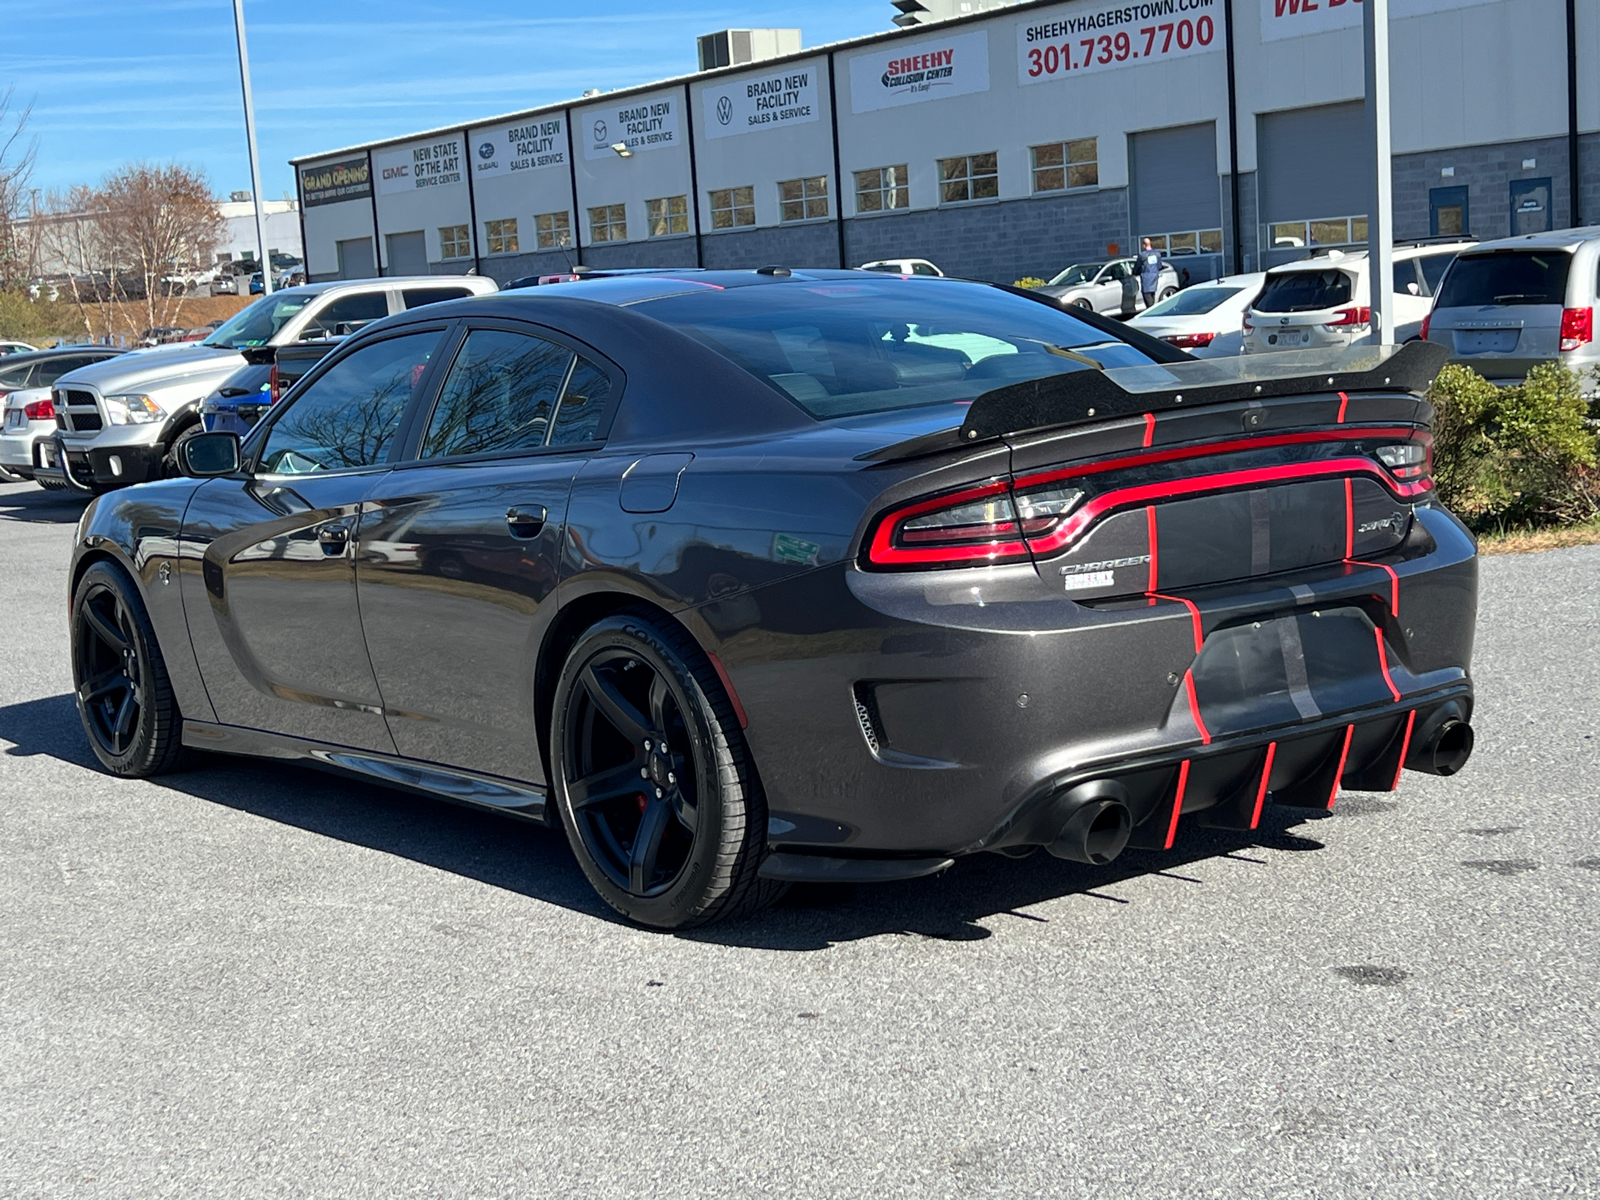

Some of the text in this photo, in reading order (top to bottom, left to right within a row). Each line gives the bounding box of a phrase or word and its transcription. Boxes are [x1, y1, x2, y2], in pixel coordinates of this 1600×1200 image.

[1028, 15, 1214, 77] 301.739.7700
[888, 48, 954, 76] SHEEHY
[747, 73, 808, 98] BRAND NEW
[889, 66, 953, 87] COLLISION CENTER
[756, 91, 799, 111] FACILITY
[619, 102, 670, 123] BRAND NEW
[748, 105, 811, 126] SALES & SERVICE
[508, 120, 560, 143] BRAND NEW
[626, 117, 663, 135] FACILITY
[517, 137, 554, 156] FACILITY
[641, 136, 646, 145] &
[647, 131, 673, 144] SERVICE
[413, 141, 458, 162] NEW STATE
[510, 152, 564, 171] SALES & SERVICE
[382, 165, 409, 180] GMC
[414, 157, 459, 177] OF THE ART
[304, 166, 368, 190] GRAND OPENING
[416, 172, 461, 188] SERVICE CENTER
[1060, 555, 1151, 575] CHARGER
